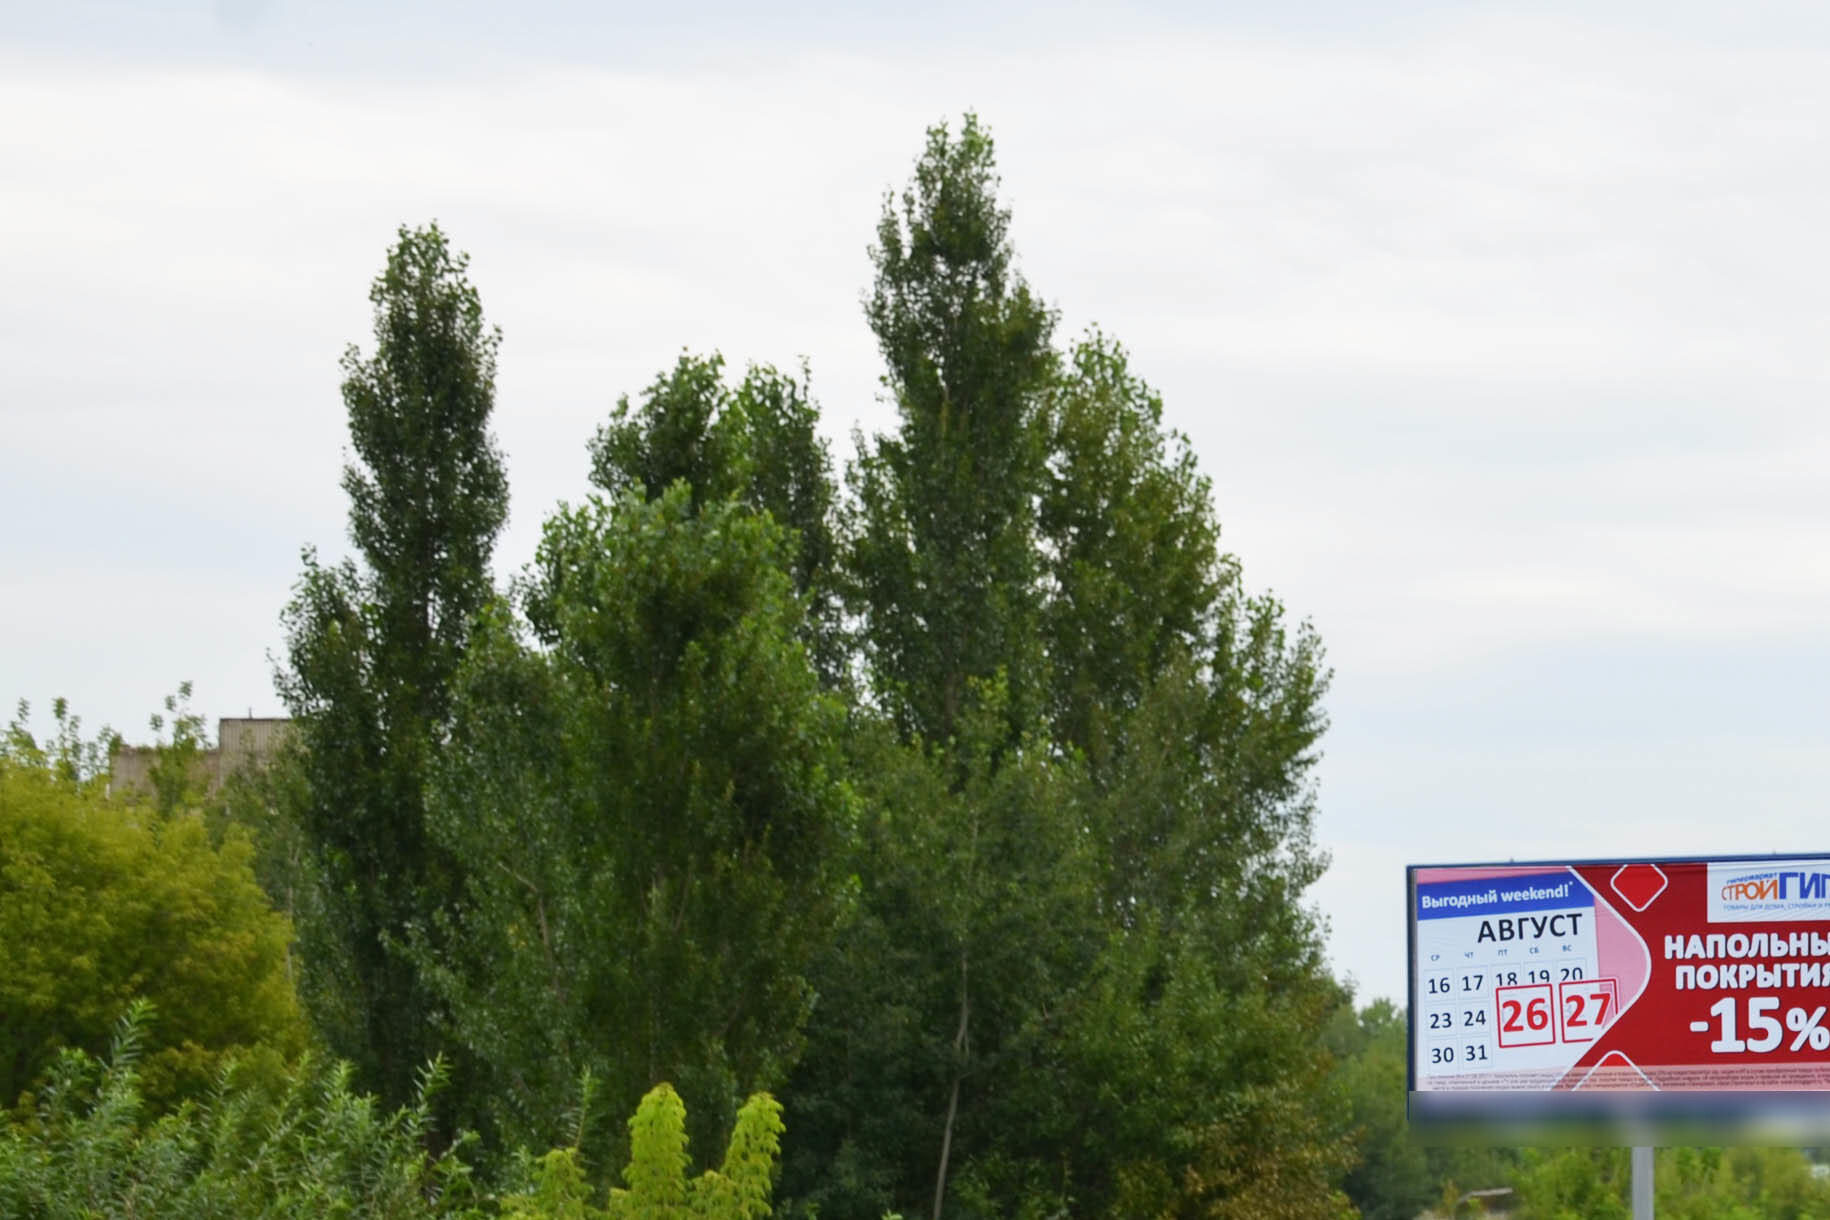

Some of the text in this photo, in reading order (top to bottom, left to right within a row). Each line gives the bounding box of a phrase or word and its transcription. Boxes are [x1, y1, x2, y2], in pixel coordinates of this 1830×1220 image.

[1421, 889, 1498, 909] Выгодный
[1477, 913, 1583, 943] АВГУСТ
[1430, 944, 1572, 962] СР ЧТ ПТ СБ ВС
[1428, 967, 1583, 994] 16 17 18 19 20
[1430, 1010, 1486, 1029] 23 24
[1502, 993, 1611, 1032] 26 27
[1432, 1044, 1488, 1064] 30 31
